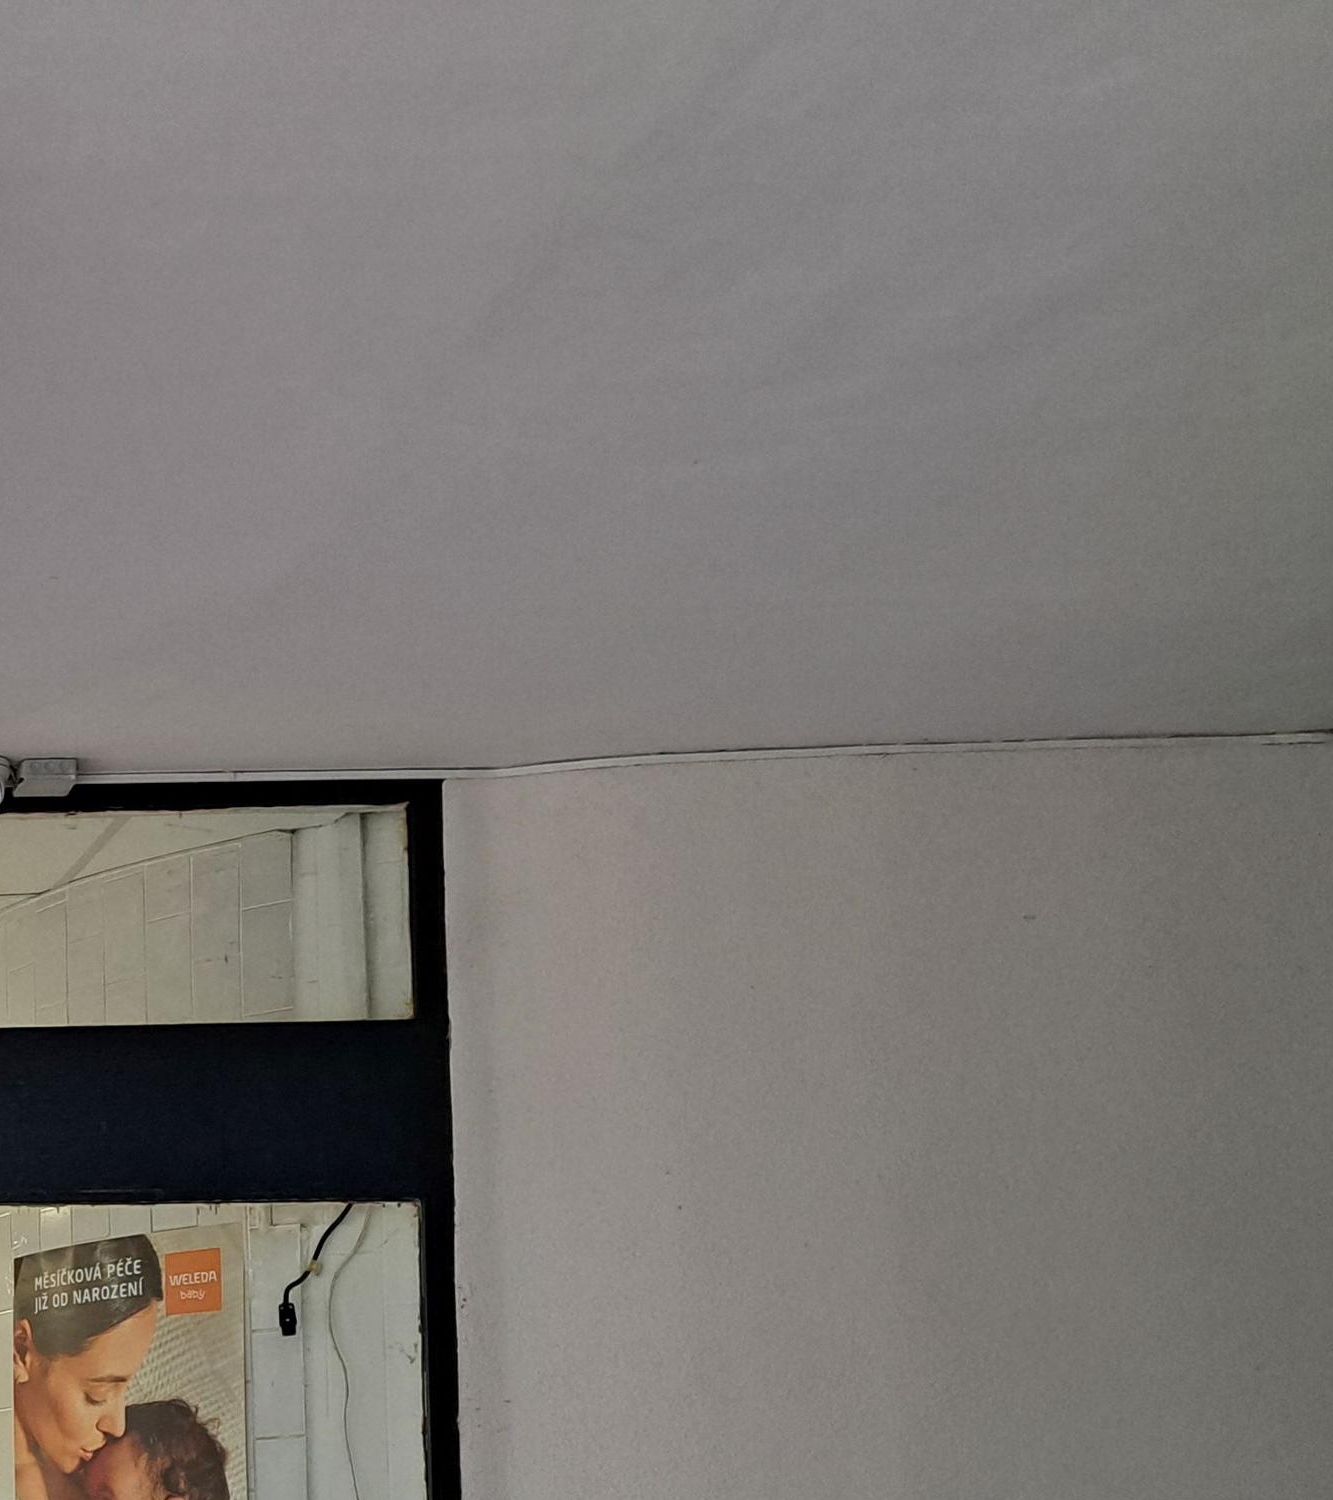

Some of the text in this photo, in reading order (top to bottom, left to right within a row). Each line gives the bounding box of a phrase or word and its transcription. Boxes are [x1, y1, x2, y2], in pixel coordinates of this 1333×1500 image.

[34, 1257, 142, 1291] MĚSÍČKOVÁ PÉČE
[169, 1271, 218, 1287] WELEDA
[34, 1277, 143, 1315] JIŽ OD NAROZENÍ
[180, 1289, 205, 1301] baby
